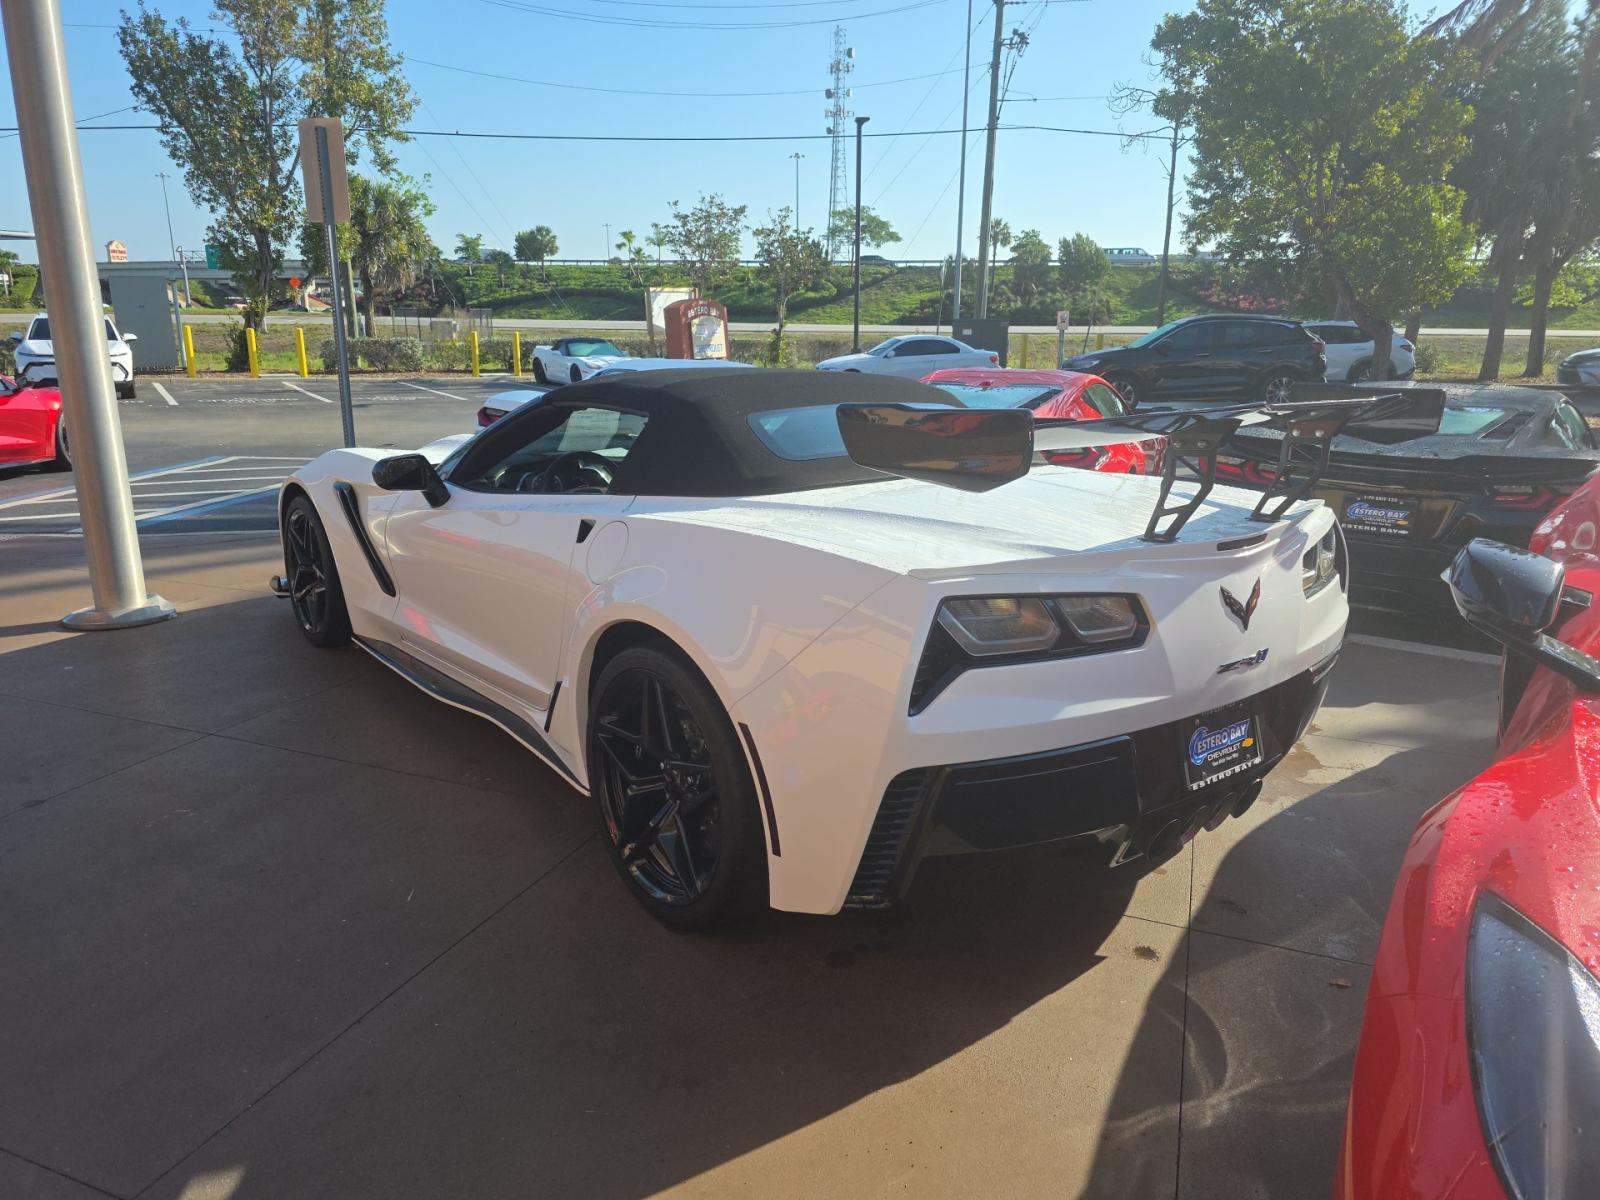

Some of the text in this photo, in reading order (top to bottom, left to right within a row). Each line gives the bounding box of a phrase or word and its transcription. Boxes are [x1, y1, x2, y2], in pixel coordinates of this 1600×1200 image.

[1354, 507, 1406, 519] ESTERO BAY
[1341, 523, 1377, 531] ESTERO
[1197, 724, 1247, 755] ESTERO BAY
[1207, 743, 1241, 762] CHEVROLET
[1191, 761, 1252, 791] ESTERO BAY
